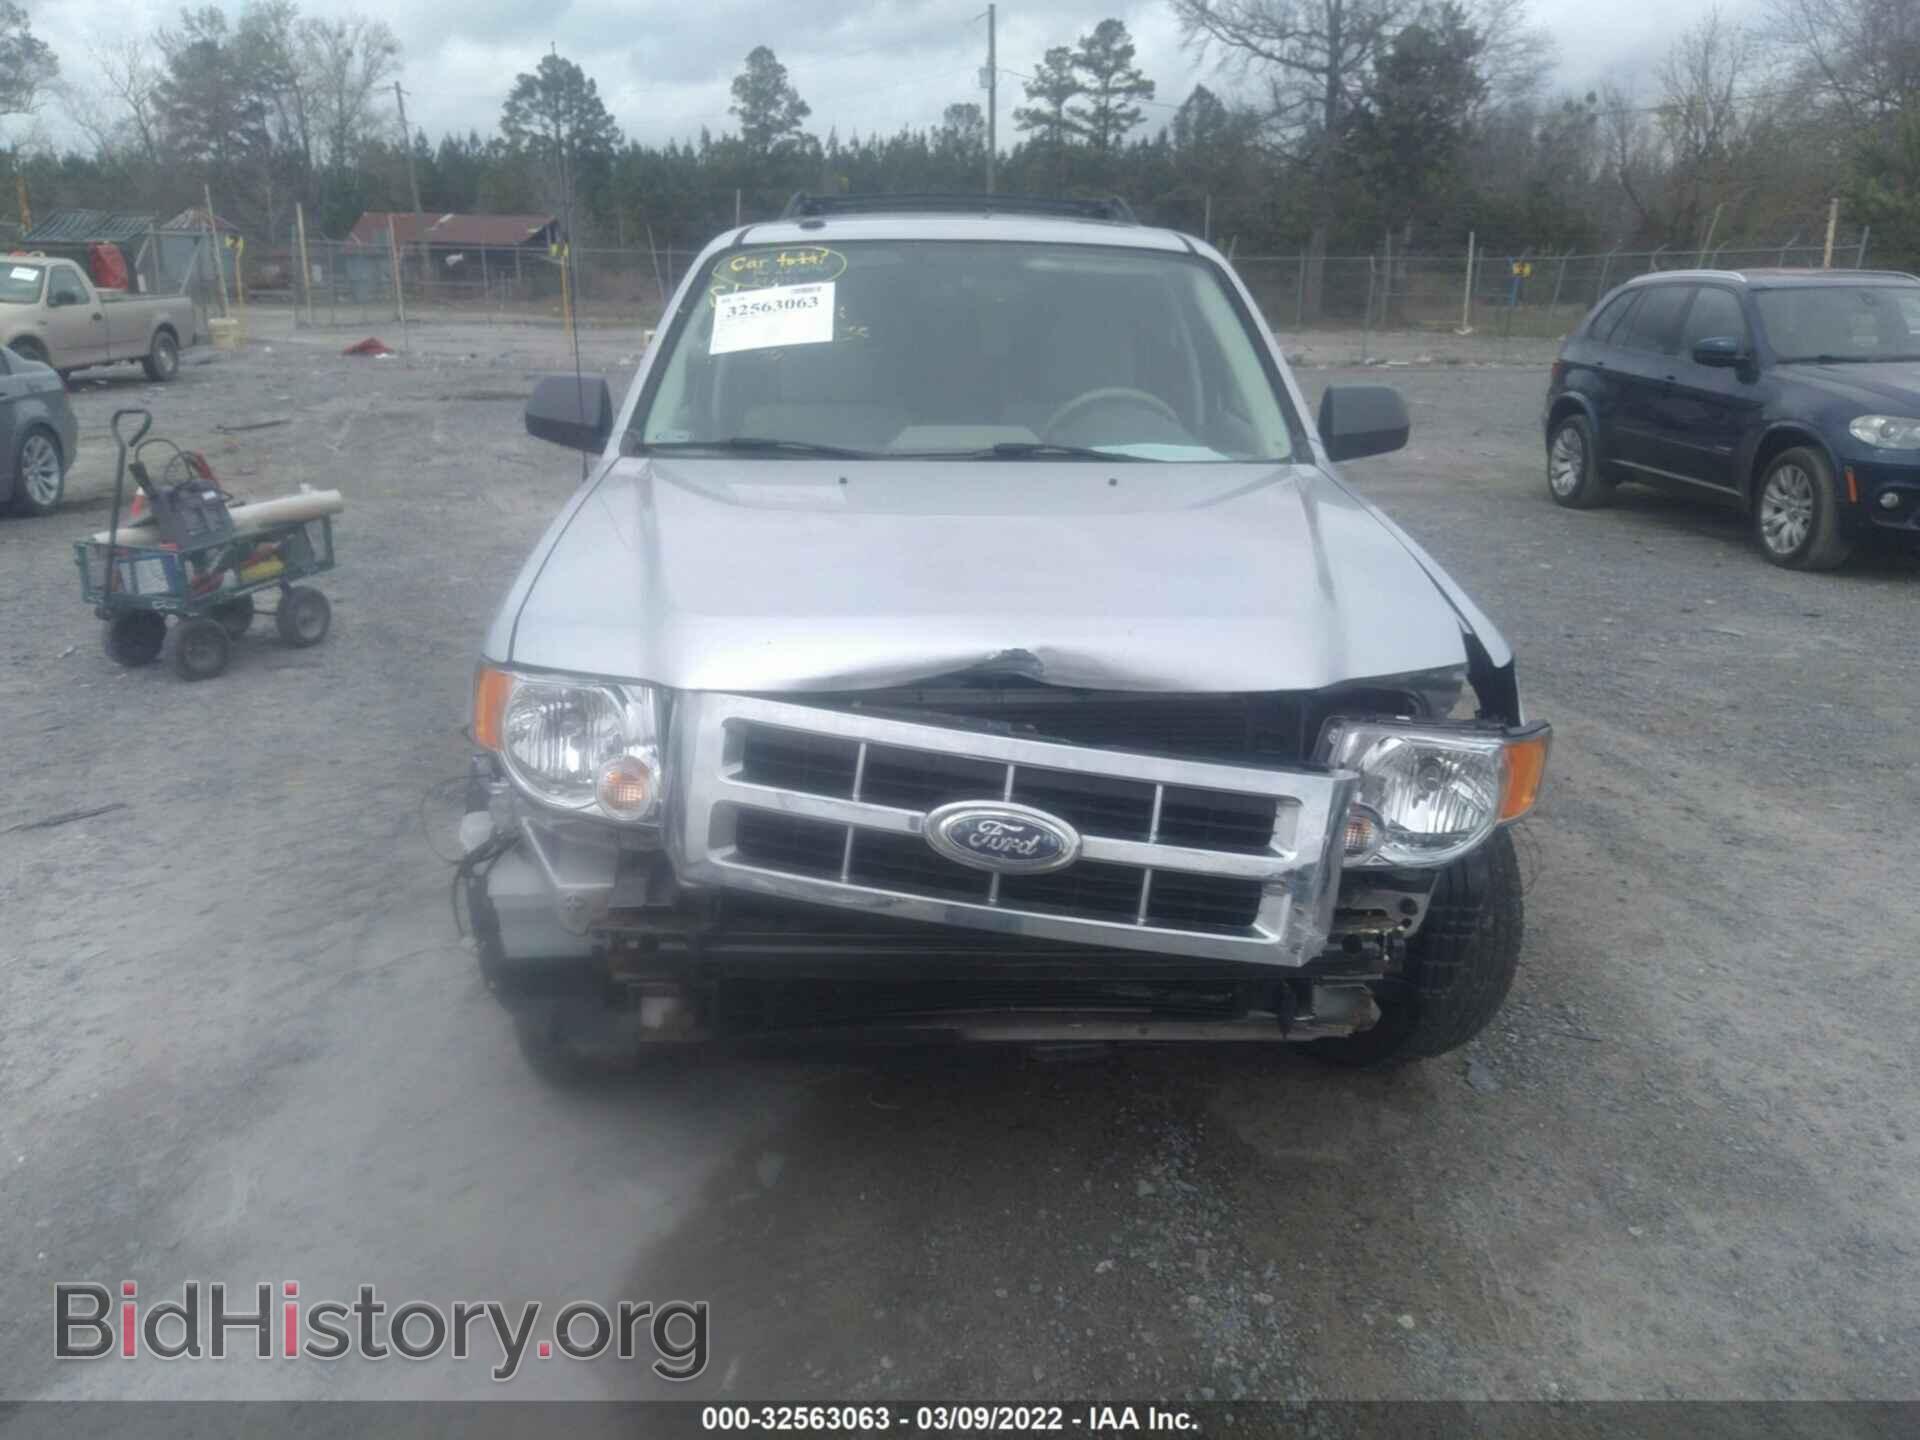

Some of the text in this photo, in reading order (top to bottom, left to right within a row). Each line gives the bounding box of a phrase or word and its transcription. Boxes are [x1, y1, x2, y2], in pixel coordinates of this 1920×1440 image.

[729, 256, 767, 272] Car
[726, 295, 820, 318] 32563063
[968, 820, 1041, 856] Ford
